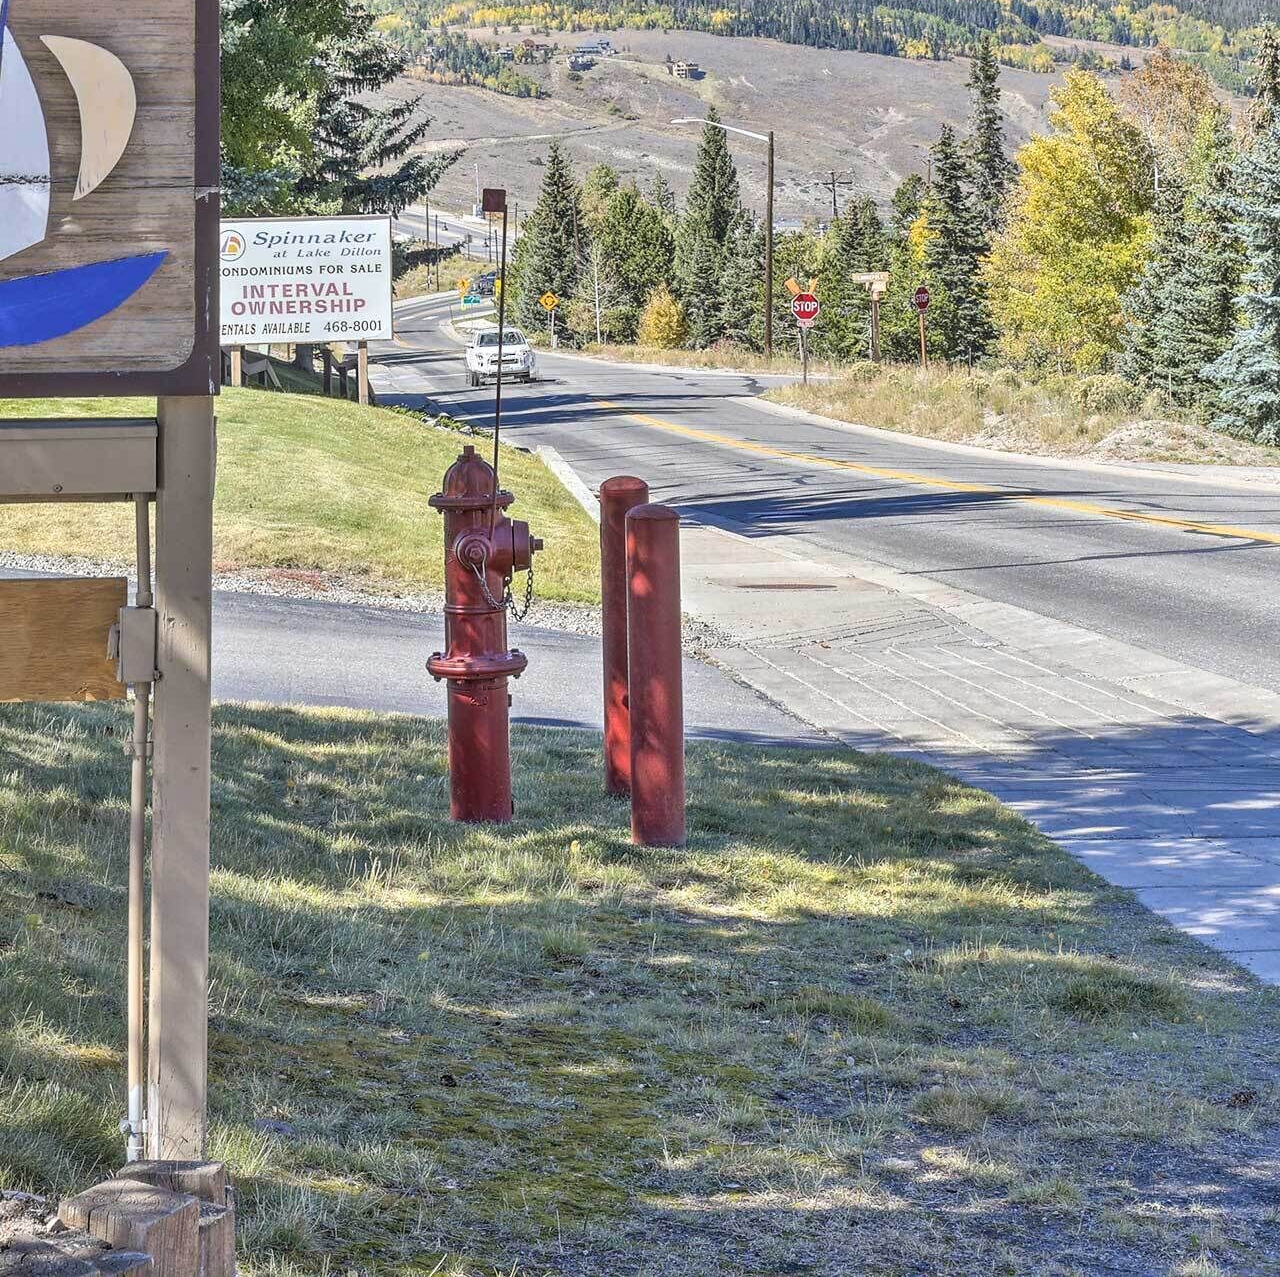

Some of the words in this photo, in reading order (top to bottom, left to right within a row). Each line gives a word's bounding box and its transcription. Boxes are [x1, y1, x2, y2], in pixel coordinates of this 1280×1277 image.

[252, 230, 377, 249] Spinnaker
[273, 249, 287, 259] at
[297, 249, 331, 258] Lake
[340, 247, 382, 257] Dillon
[220, 265, 313, 277] ONDOMINIUMS
[319, 264, 344, 275] FOR
[350, 263, 382, 274] SALE
[242, 282, 354, 299] INTERVAL
[915, 293, 929, 303] STOP
[231, 298, 367, 316] OWNERSHIP
[793, 301, 818, 313] STOP
[220, 323, 257, 336] ENTALS
[261, 322, 311, 335] AVAILABLE
[323, 320, 382, 333] 468-8001
